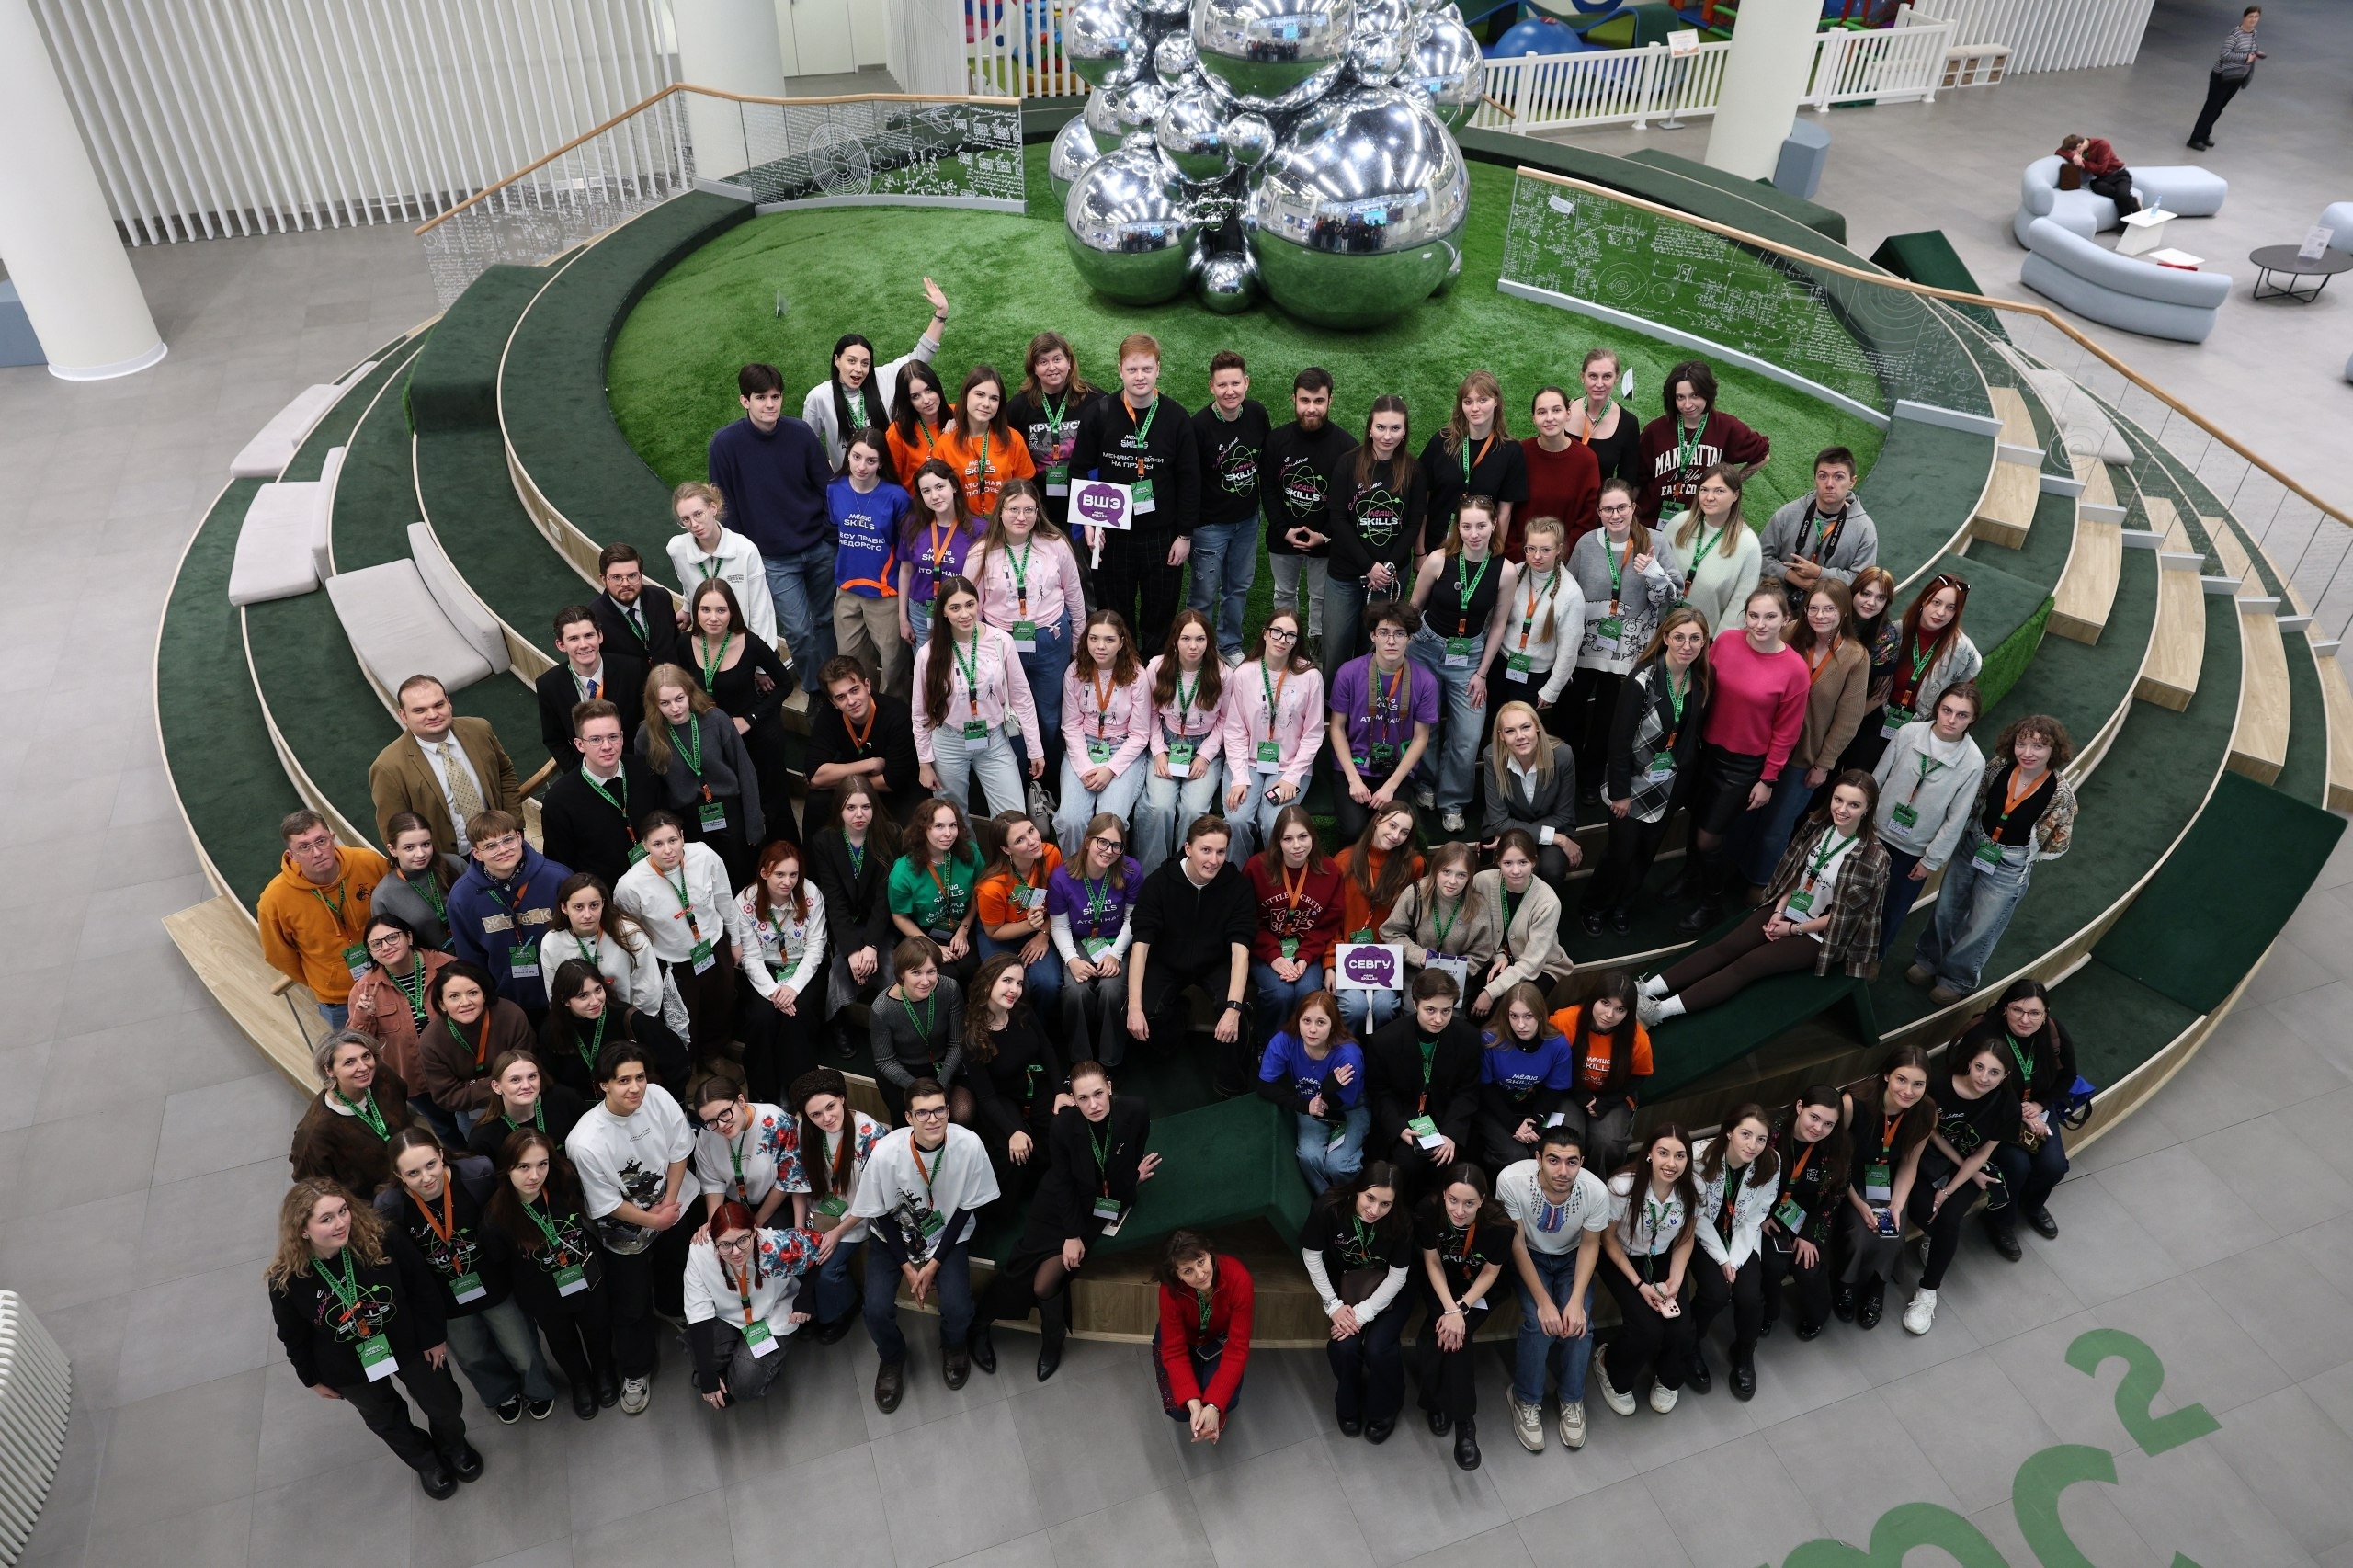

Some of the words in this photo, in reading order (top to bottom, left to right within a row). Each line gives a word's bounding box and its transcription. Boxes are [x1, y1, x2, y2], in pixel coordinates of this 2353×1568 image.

[1654, 443, 1722, 478] MANATTA
[1225, 466, 1256, 481] SKILLS
[965, 480, 1002, 490] АТОНАЯ
[1285, 487, 1320, 502] SKILLS
[1083, 494, 1121, 509] ВШЭ
[844, 518, 875, 530] SKILLS
[1359, 517, 1399, 526] SKILLS
[839, 540, 882, 551] НЕДОРОГО
[1261, 892, 1289, 908] LITTLE
[1348, 960, 1391, 969] СЕВГУ
